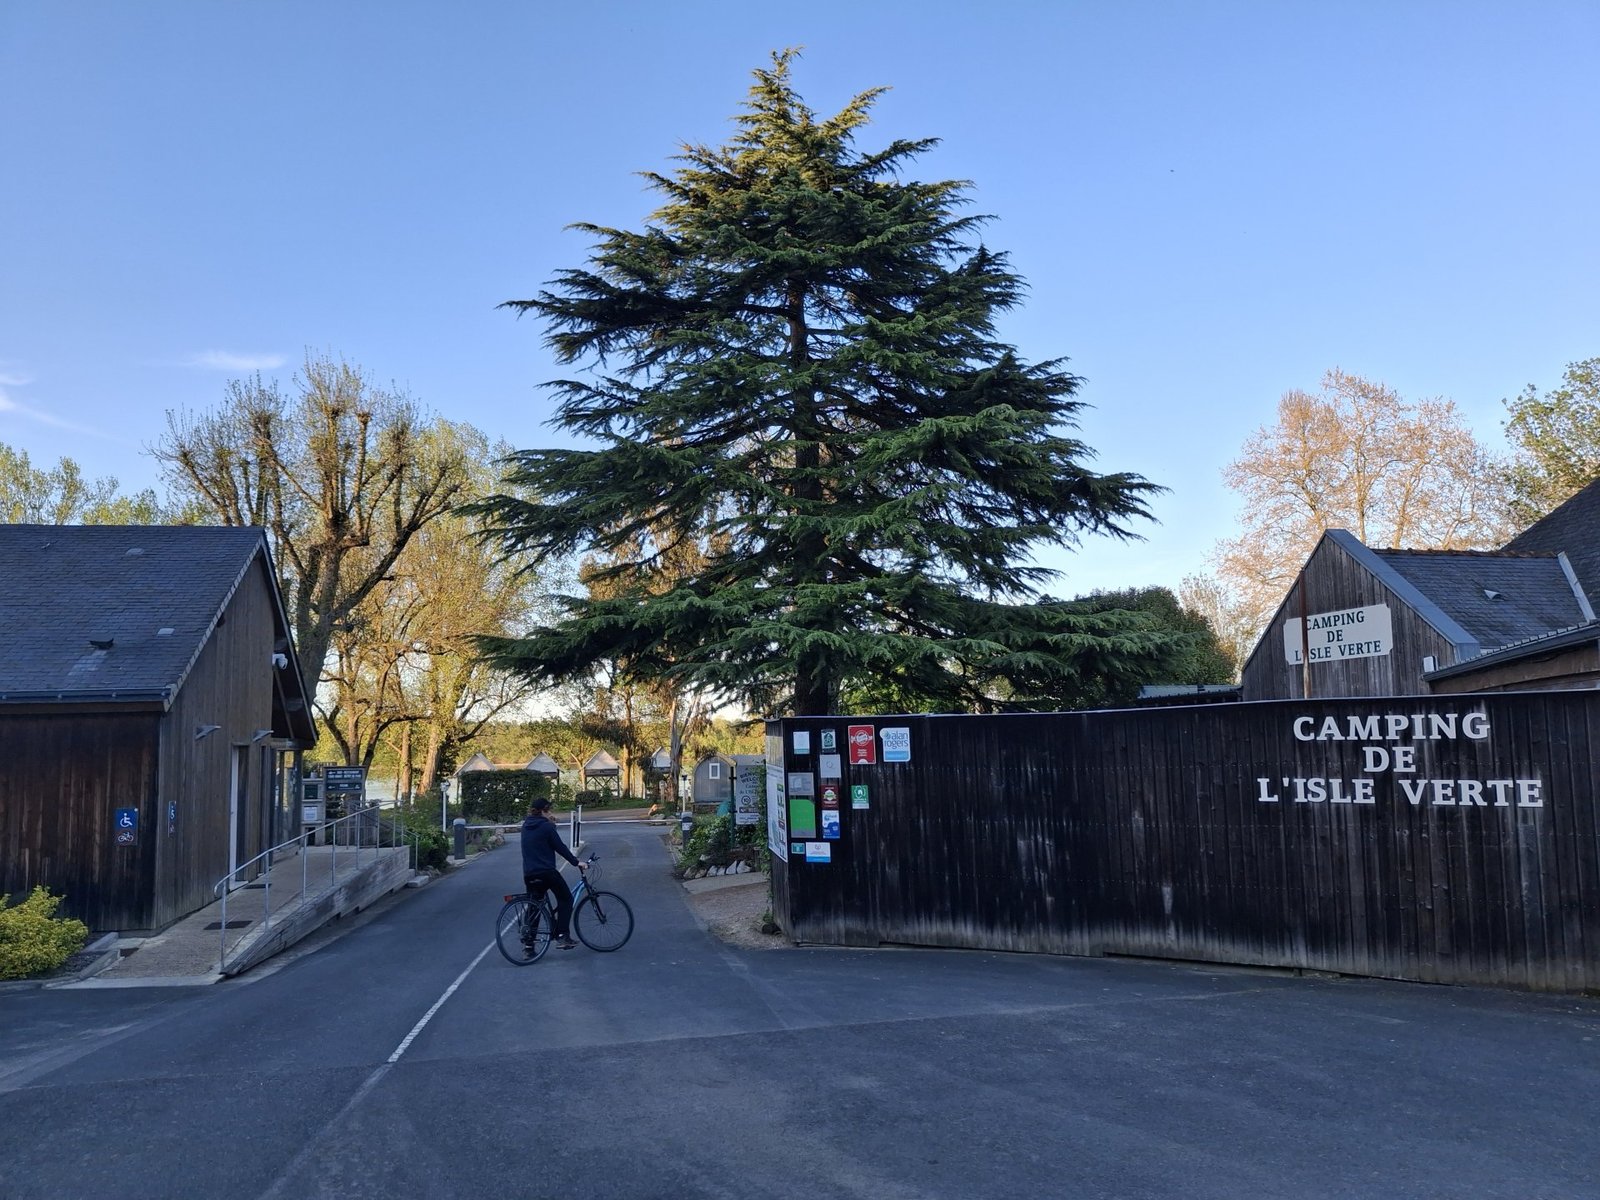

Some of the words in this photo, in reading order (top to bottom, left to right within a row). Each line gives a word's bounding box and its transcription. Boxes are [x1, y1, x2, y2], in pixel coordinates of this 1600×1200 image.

[1306, 611, 1365, 631] CAMPING
[1327, 630, 1344, 643] DE
[1295, 646, 1332, 661] LSLE
[1338, 640, 1382, 656] VERTE
[892, 731, 908, 740] alan
[1293, 713, 1490, 740] CAMPING
[884, 740, 909, 750] rogers
[1362, 746, 1416, 772] DE
[1257, 777, 1376, 804] L'ISLE
[1399, 779, 1544, 808] VERTE
